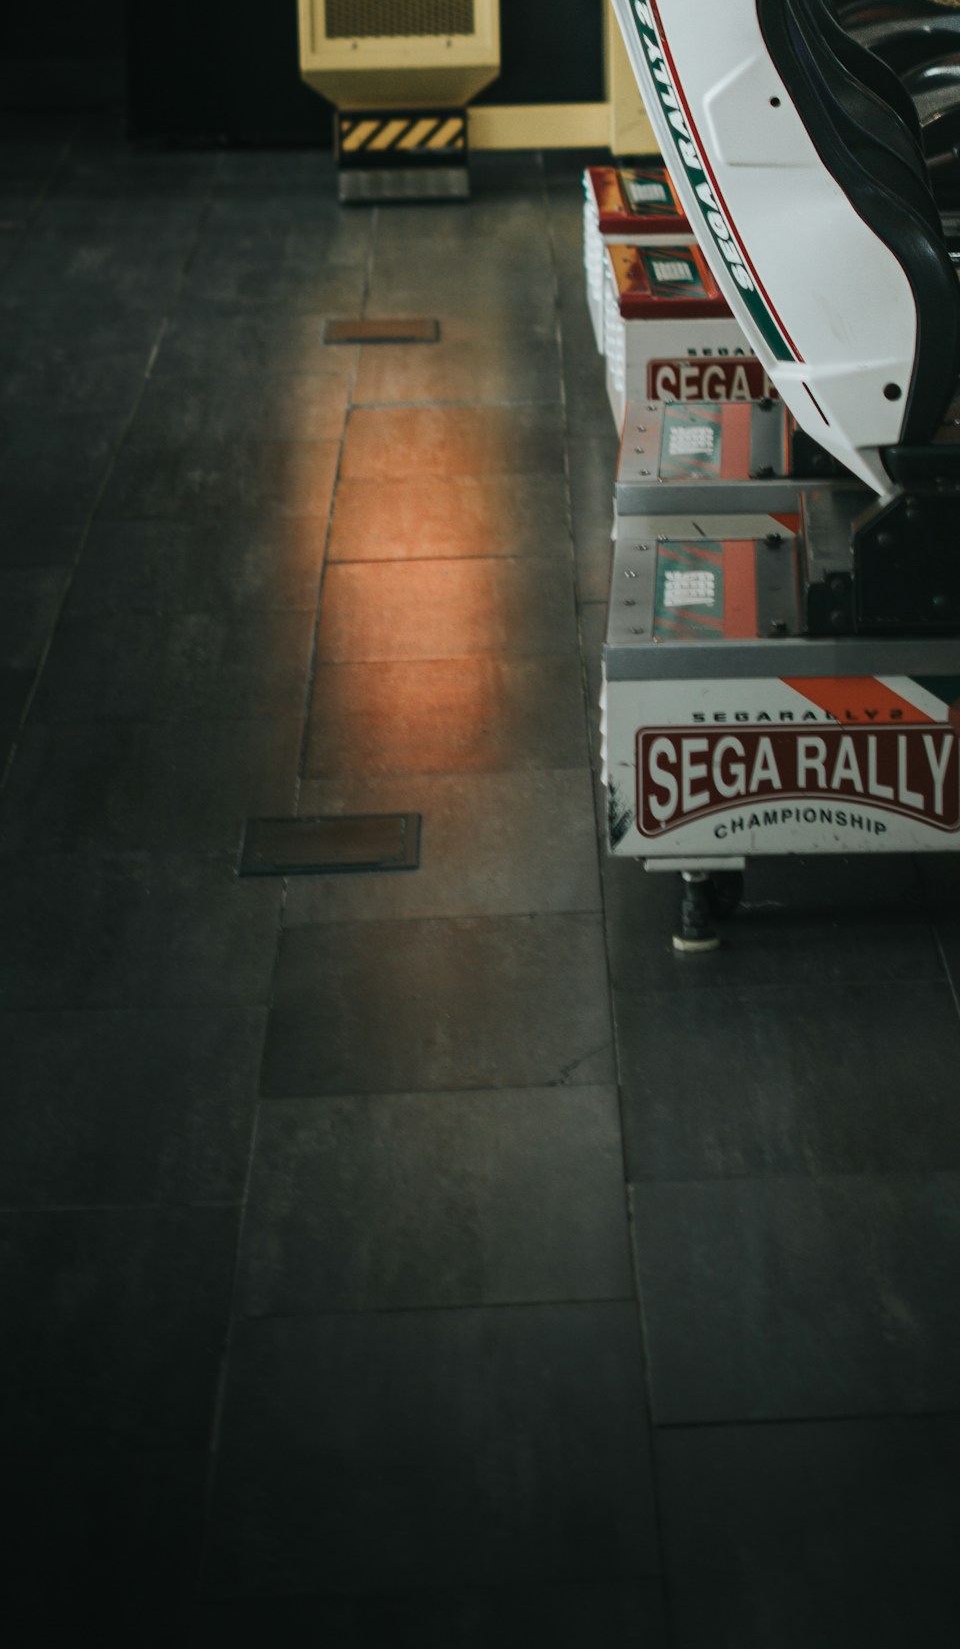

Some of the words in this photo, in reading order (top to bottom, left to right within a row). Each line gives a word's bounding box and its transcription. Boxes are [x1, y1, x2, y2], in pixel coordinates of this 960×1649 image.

[641, 32, 703, 171] RALLY
[694, 181, 757, 292] SEGA
[647, 735, 783, 822] SEGA
[796, 734, 955, 817] RALLY
[713, 808, 888, 841] CHAMPIONSHIP
